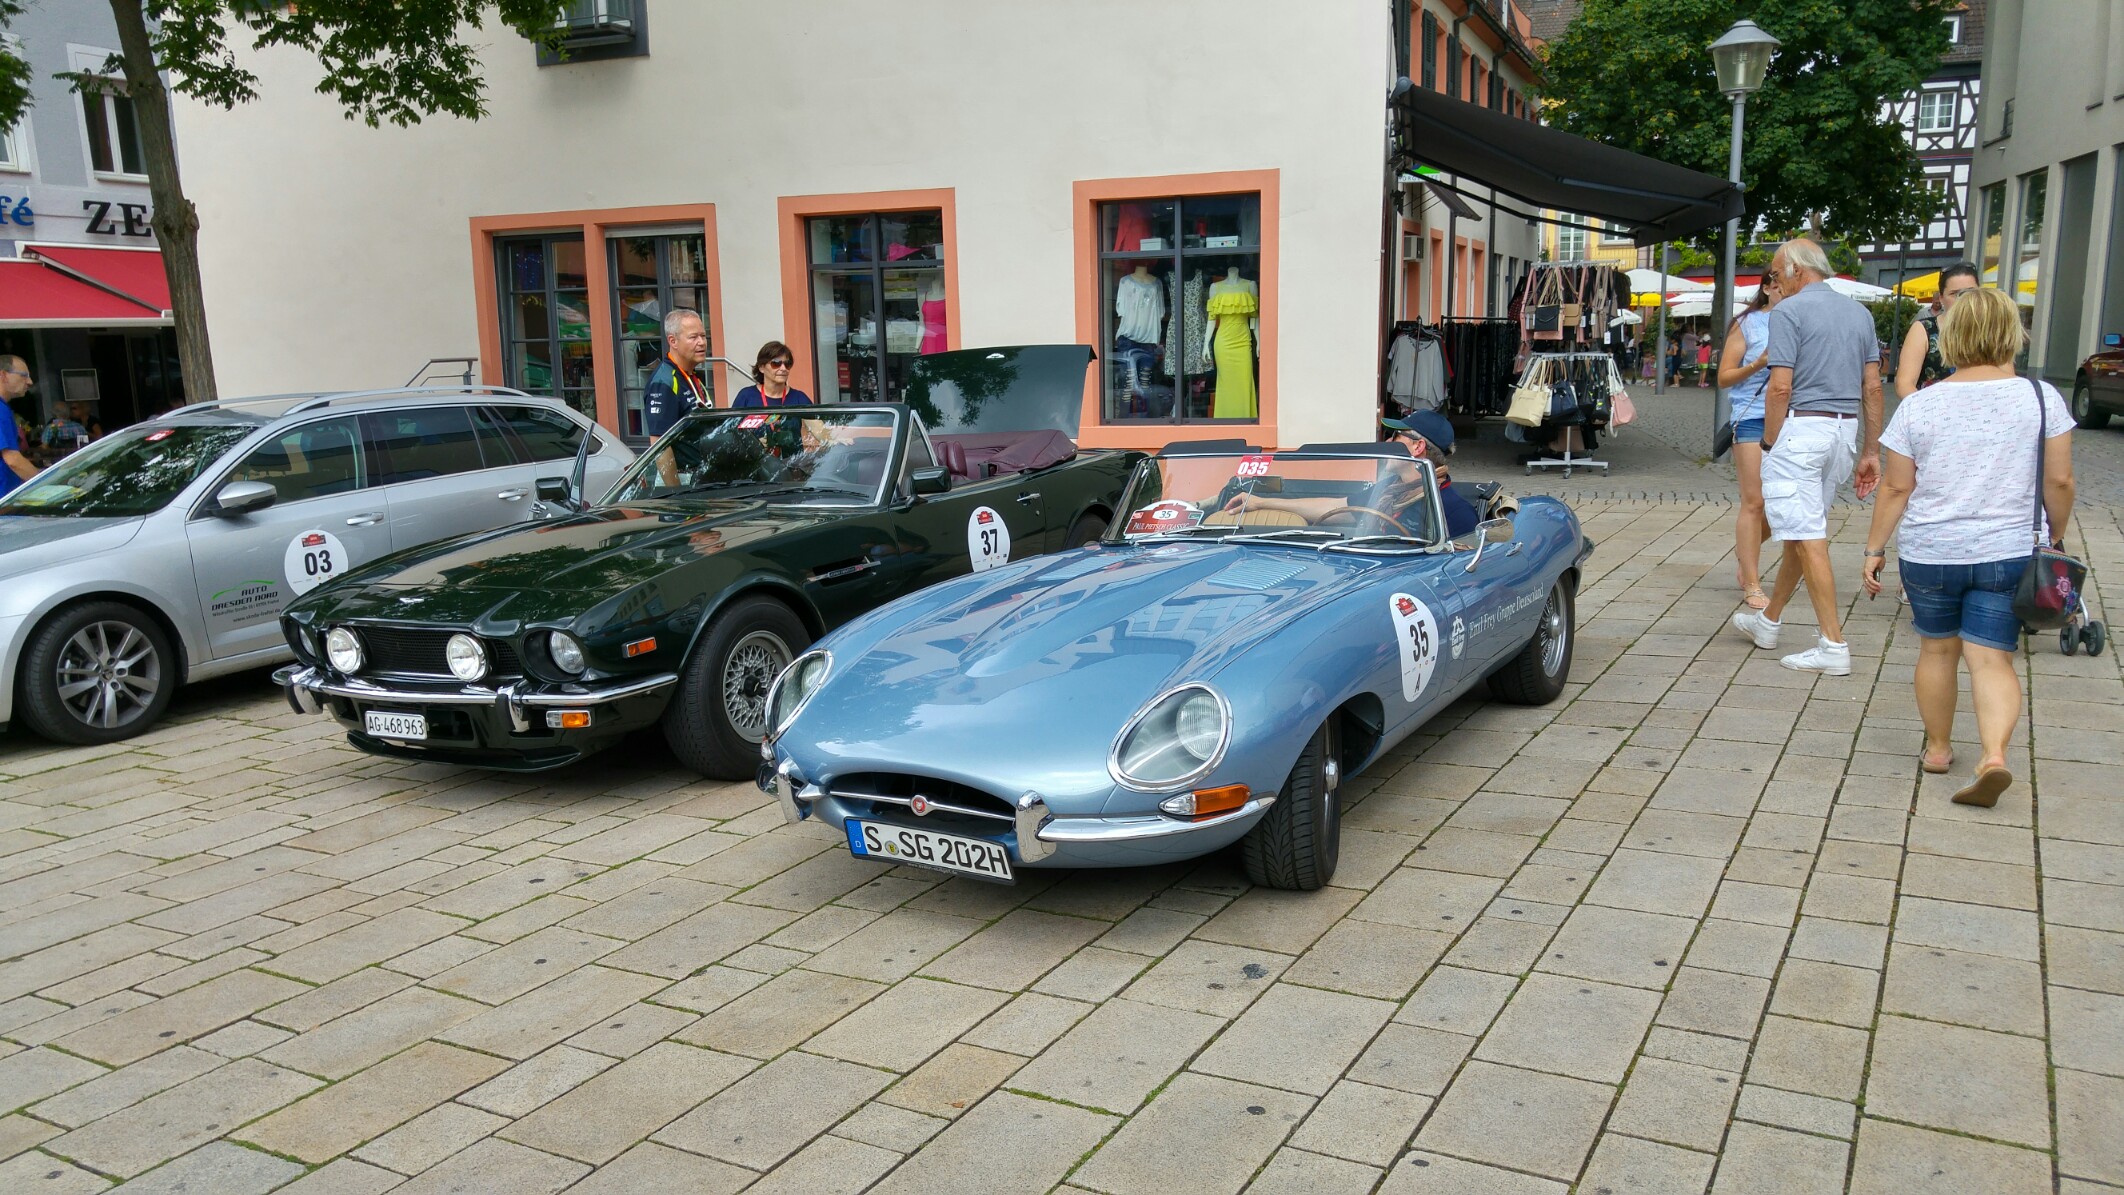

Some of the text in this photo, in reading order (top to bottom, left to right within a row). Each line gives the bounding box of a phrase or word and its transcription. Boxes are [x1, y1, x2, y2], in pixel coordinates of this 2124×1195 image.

[83, 200, 155, 237] ZE
[1238, 461, 1270, 475] 035
[1160, 511, 1173, 519] 35
[980, 528, 998, 556] 37
[304, 549, 333, 576] 03
[241, 585, 268, 597] AUTO
[254, 591, 278, 602] NORD
[1409, 619, 1429, 662] 35
[865, 826, 1008, 875] S SG 202H
